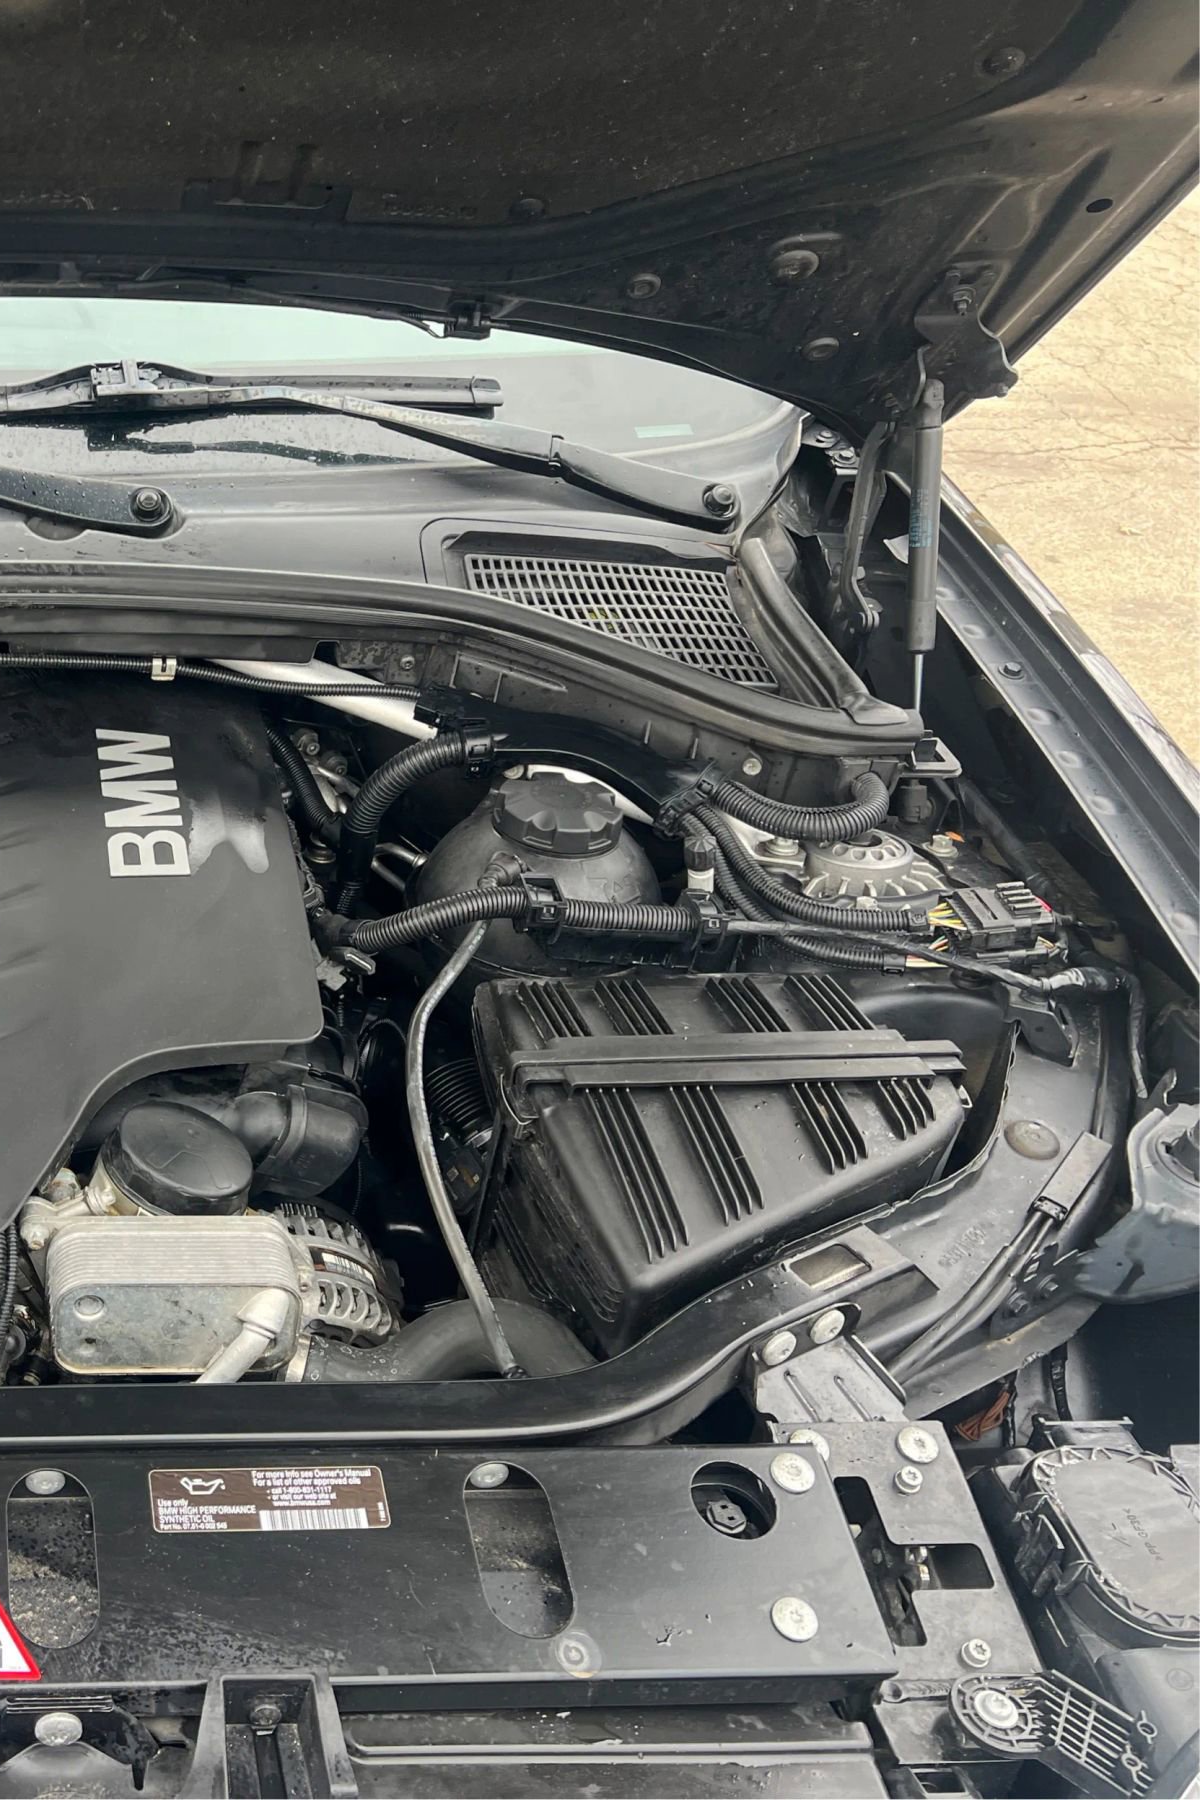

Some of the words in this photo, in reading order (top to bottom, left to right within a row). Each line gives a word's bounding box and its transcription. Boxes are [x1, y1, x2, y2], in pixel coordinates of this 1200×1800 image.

[95, 728, 191, 877] BMW
[251, 1470, 264, 1479] For
[265, 1470, 284, 1478] more
[285, 1469, 300, 1478] info
[314, 1469, 344, 1477] Owner's
[344, 1468, 371, 1477] Manual
[272, 1478, 283, 1486] list
[284, 1478, 292, 1486] of
[313, 1477, 347, 1486] approved
[157, 1498, 171, 1507] Use
[173, 1498, 188, 1507] only
[158, 1507, 178, 1515] BMW
[179, 1506, 198, 1514] HIGH
[199, 1505, 256, 1514] PERFORMANCE
[159, 1515, 201, 1524] SYNTHETIC
[202, 1515, 215, 1523] OIL
